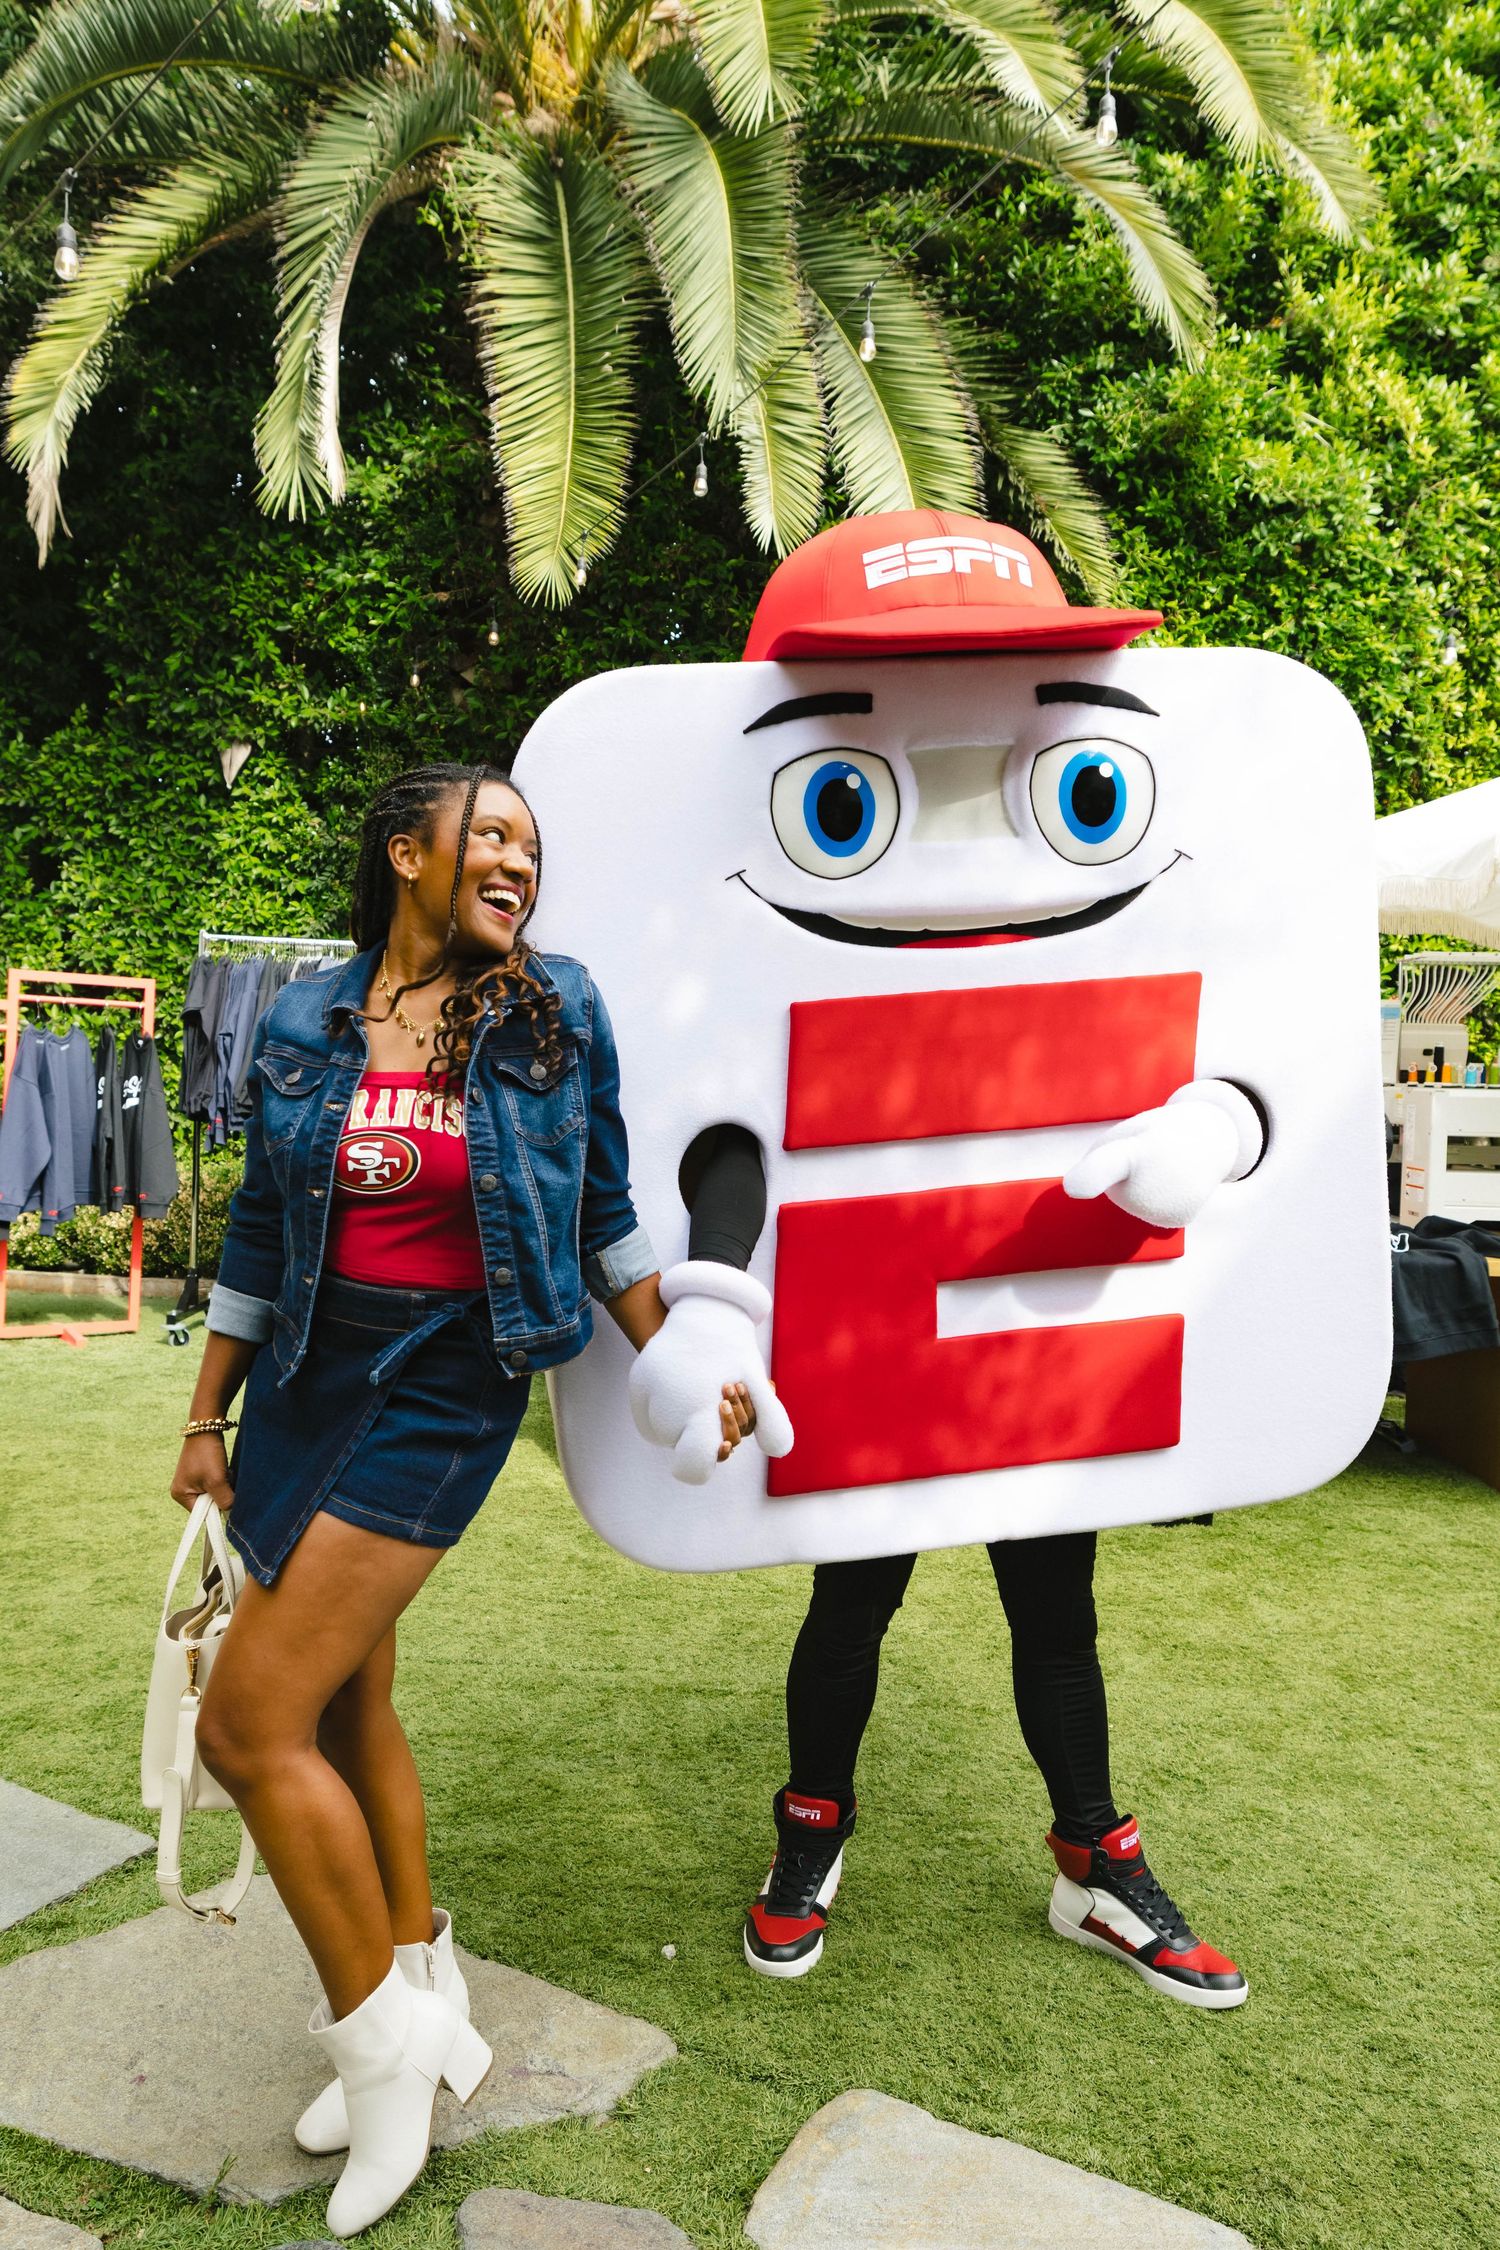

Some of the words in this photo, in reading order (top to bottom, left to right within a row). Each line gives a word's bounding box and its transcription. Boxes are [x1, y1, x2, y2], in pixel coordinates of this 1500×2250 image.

[862, 535, 1033, 590] ESPN
[349, 1088, 467, 1138] RANCIS
[346, 1141, 401, 1185] SF
[788, 1803, 821, 1820] ESPN
